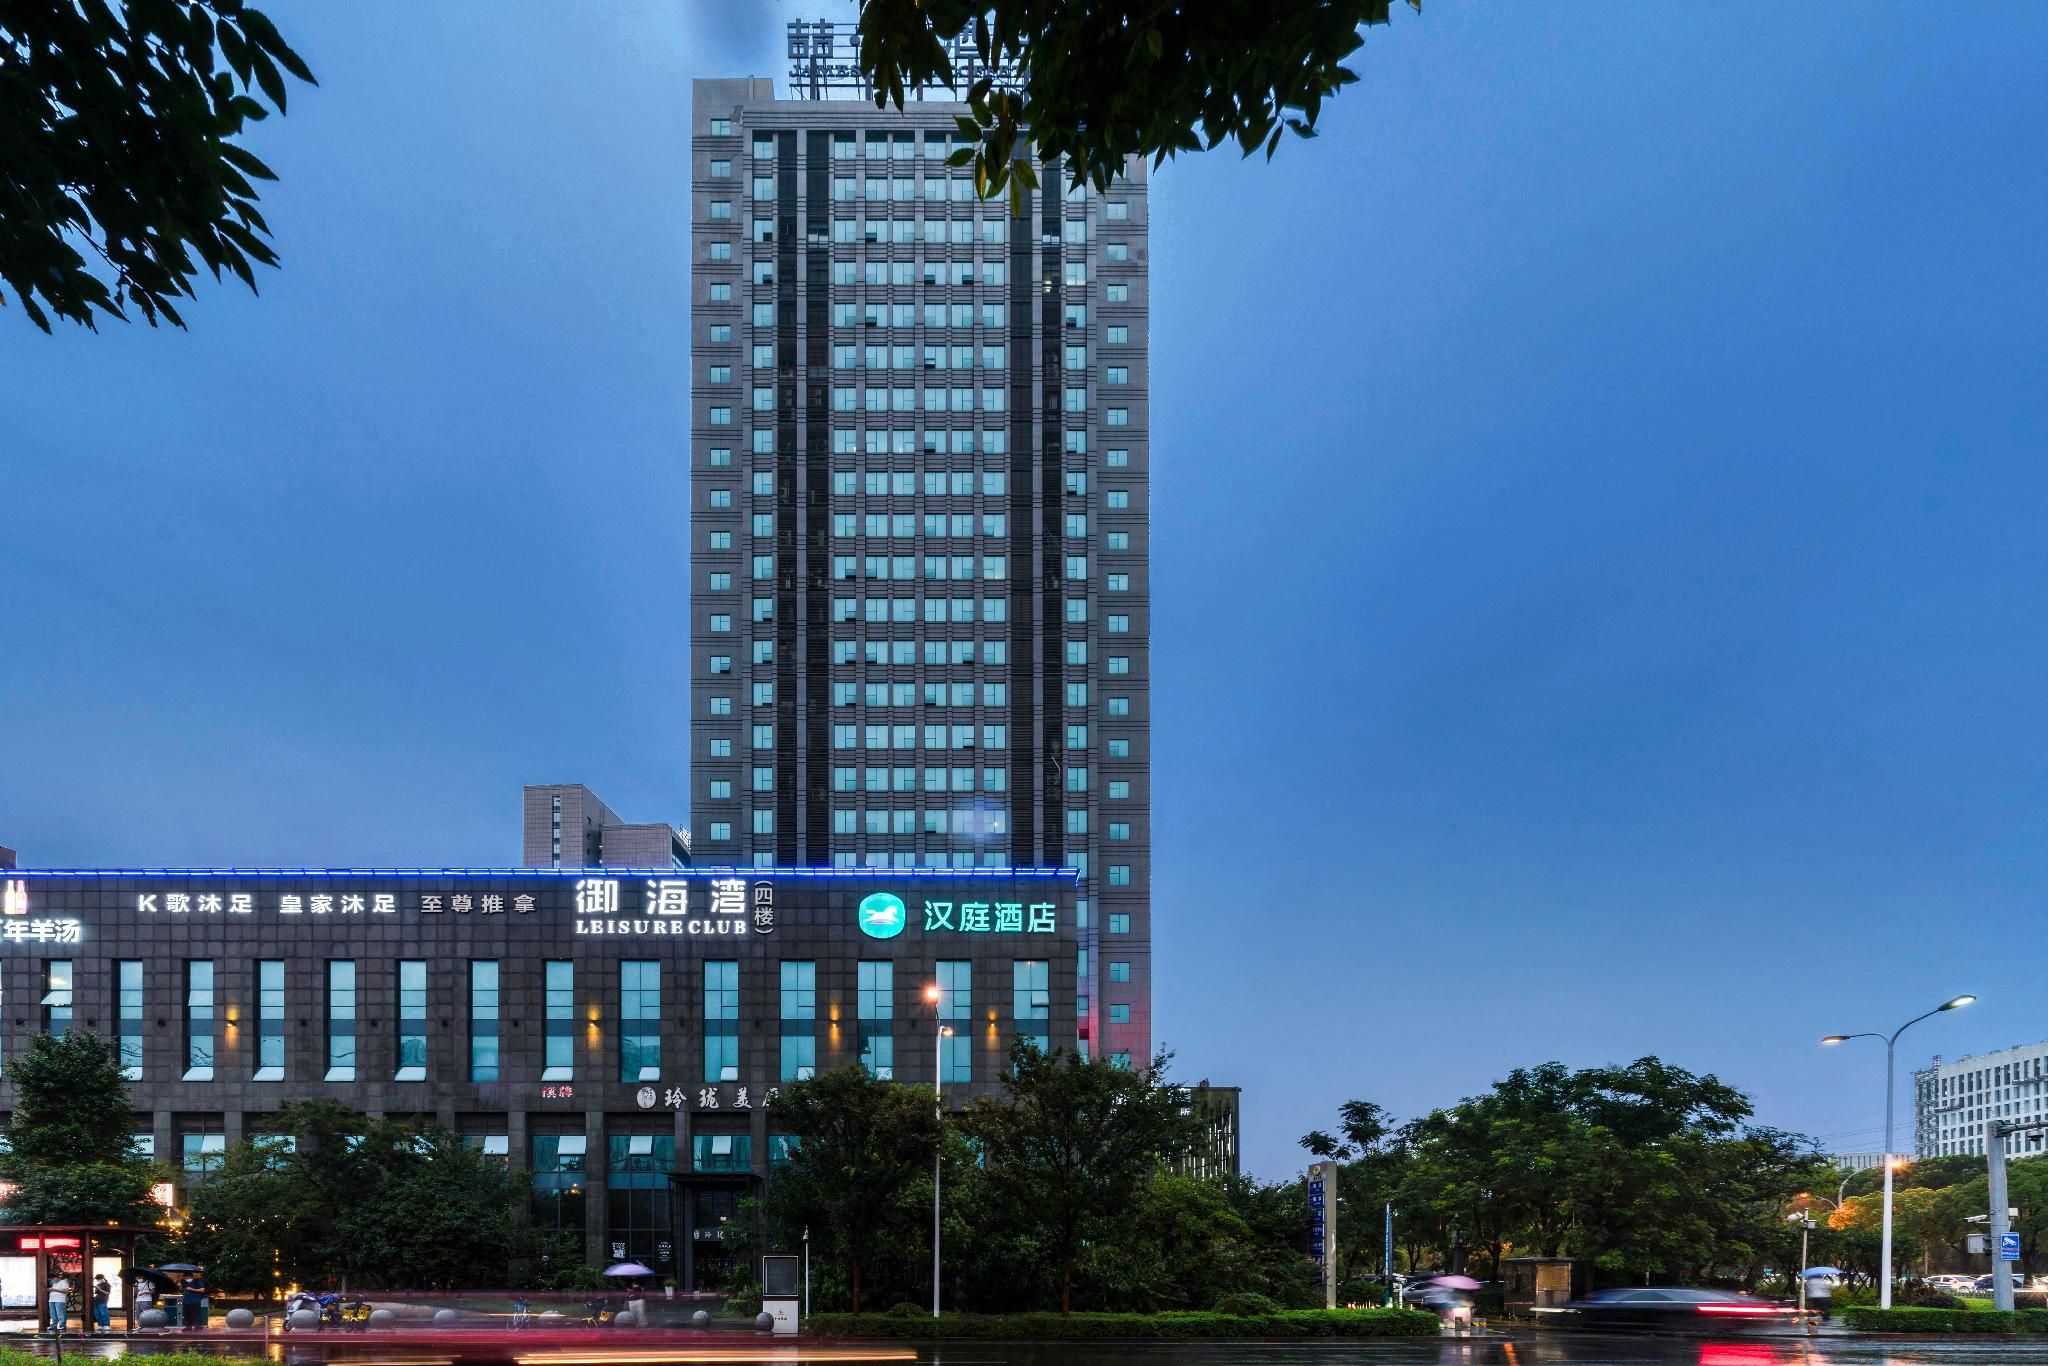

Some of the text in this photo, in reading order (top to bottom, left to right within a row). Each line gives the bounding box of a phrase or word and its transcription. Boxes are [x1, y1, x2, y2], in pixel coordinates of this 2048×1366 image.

[138, 893, 536, 914] K歌沐足 皇家沐足 至尊推拿
[575, 879, 747, 915] 御海湾
[576, 920, 747, 934] LEISURE CLUB
[924, 900, 1056, 933] 汉庭酒店
[0, 918, 82, 943] 年羊汤
